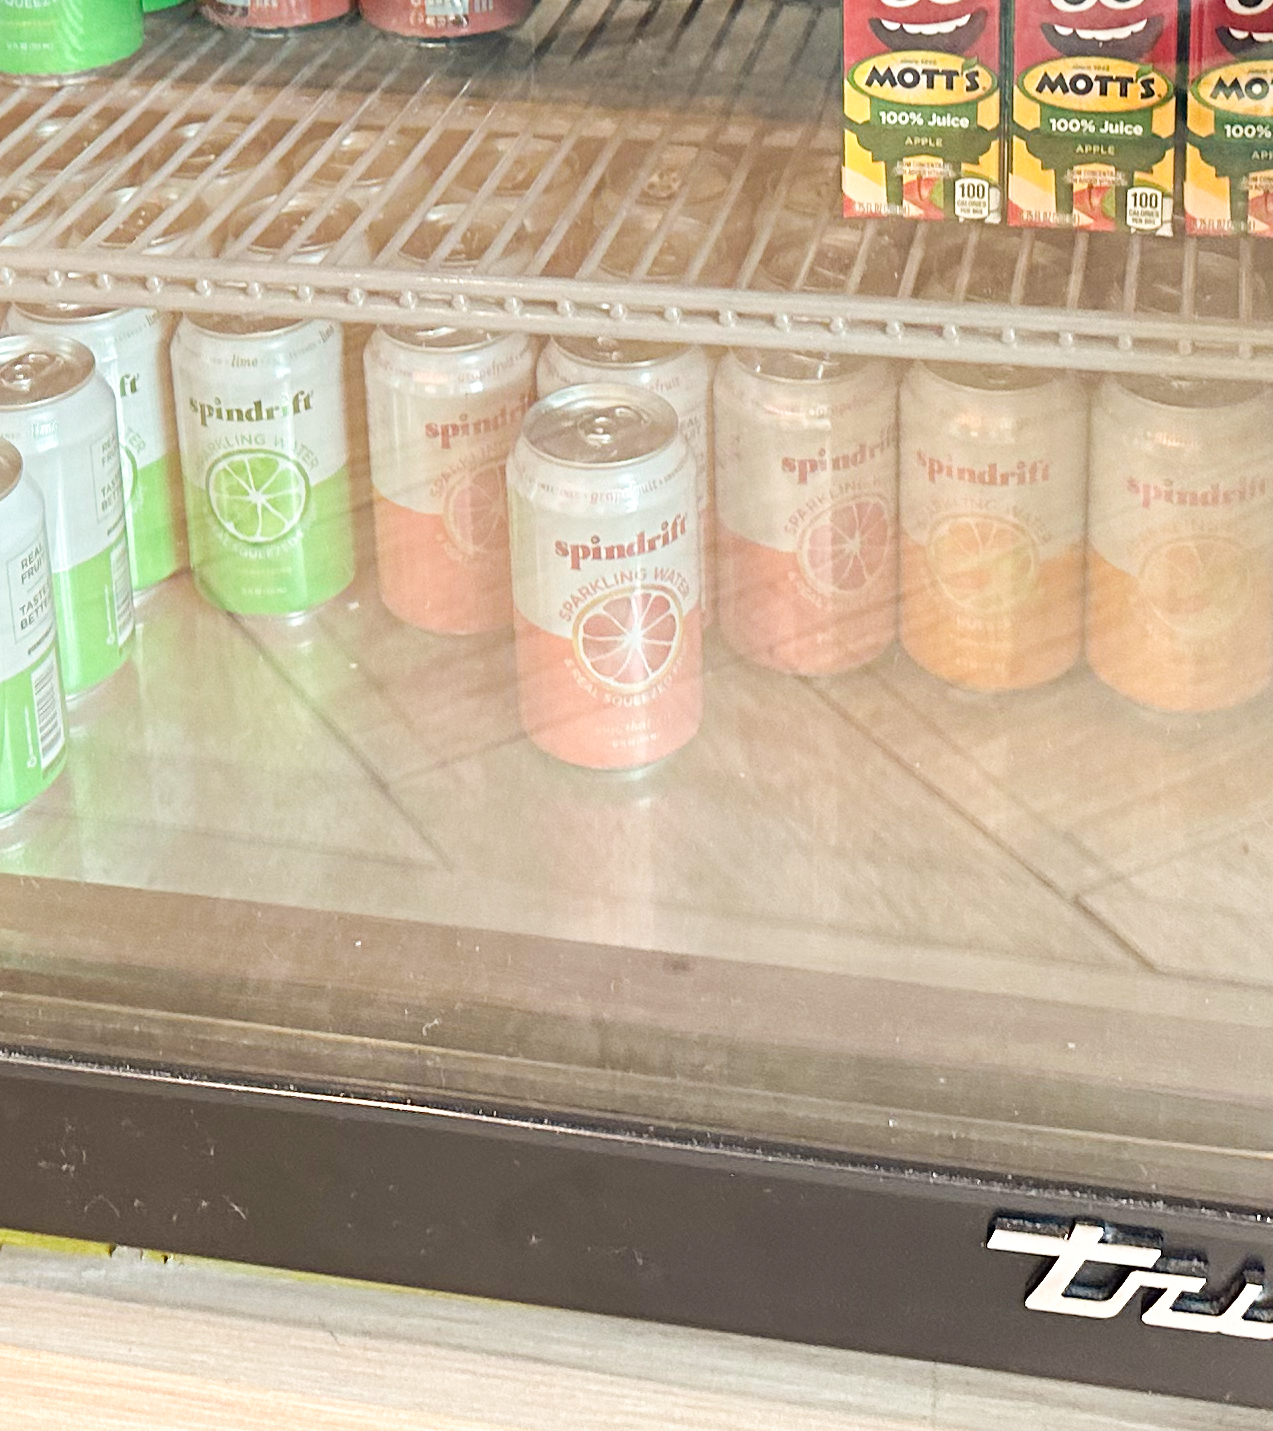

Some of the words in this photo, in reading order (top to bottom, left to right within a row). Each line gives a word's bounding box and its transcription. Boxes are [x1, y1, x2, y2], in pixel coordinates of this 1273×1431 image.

[865, 65, 980, 92] MOTT'S
[1035, 71, 1155, 100] MOTT'S
[879, 111, 924, 126] 100%
[928, 112, 970, 129] Juice
[1049, 118, 1095, 133] 100%
[1099, 120, 1143, 136] Juice
[1224, 124, 1272, 139] 100%
[904, 136, 943, 147] APPLE
[1075, 144, 1115, 156] APPLE
[958, 182, 986, 199] 100
[1130, 191, 1158, 209] 100
[231, 354, 259, 369] lime
[189, 389, 314, 427] spindrift
[554, 513, 688, 571] spindrift
[559, 569, 647, 623] SPARKLING
[653, 566, 691, 600] WATER
